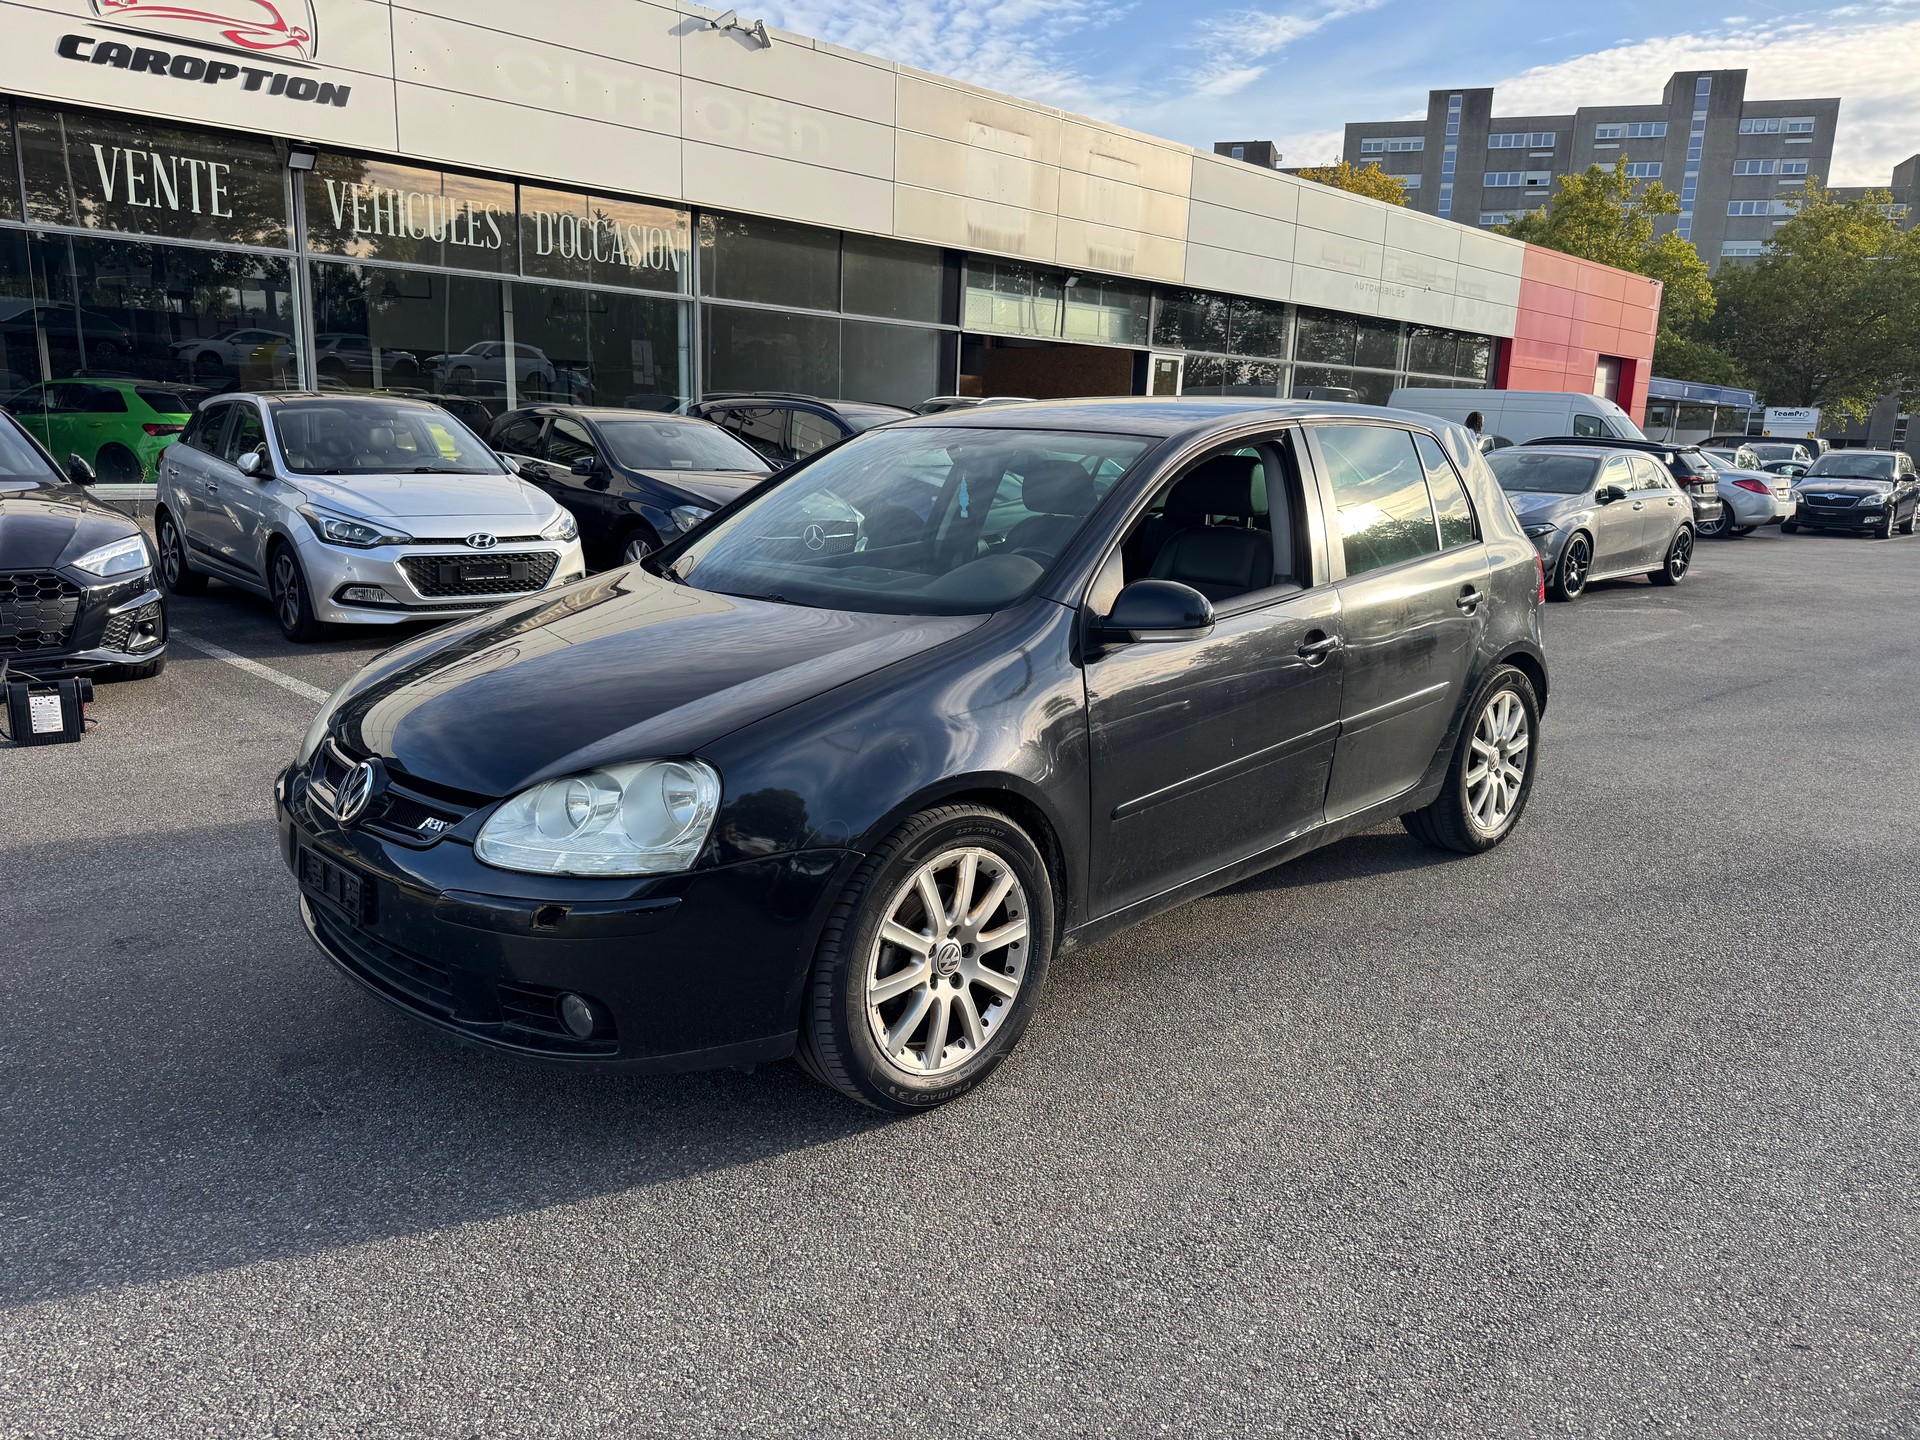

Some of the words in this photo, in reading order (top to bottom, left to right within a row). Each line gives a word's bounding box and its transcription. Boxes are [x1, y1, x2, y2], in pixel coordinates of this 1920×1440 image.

[57, 34, 351, 107] CAROPTION
[90, 143, 232, 218] VENTE
[324, 179, 502, 250] VEHICULES
[536, 210, 680, 272] D'OCCASION
